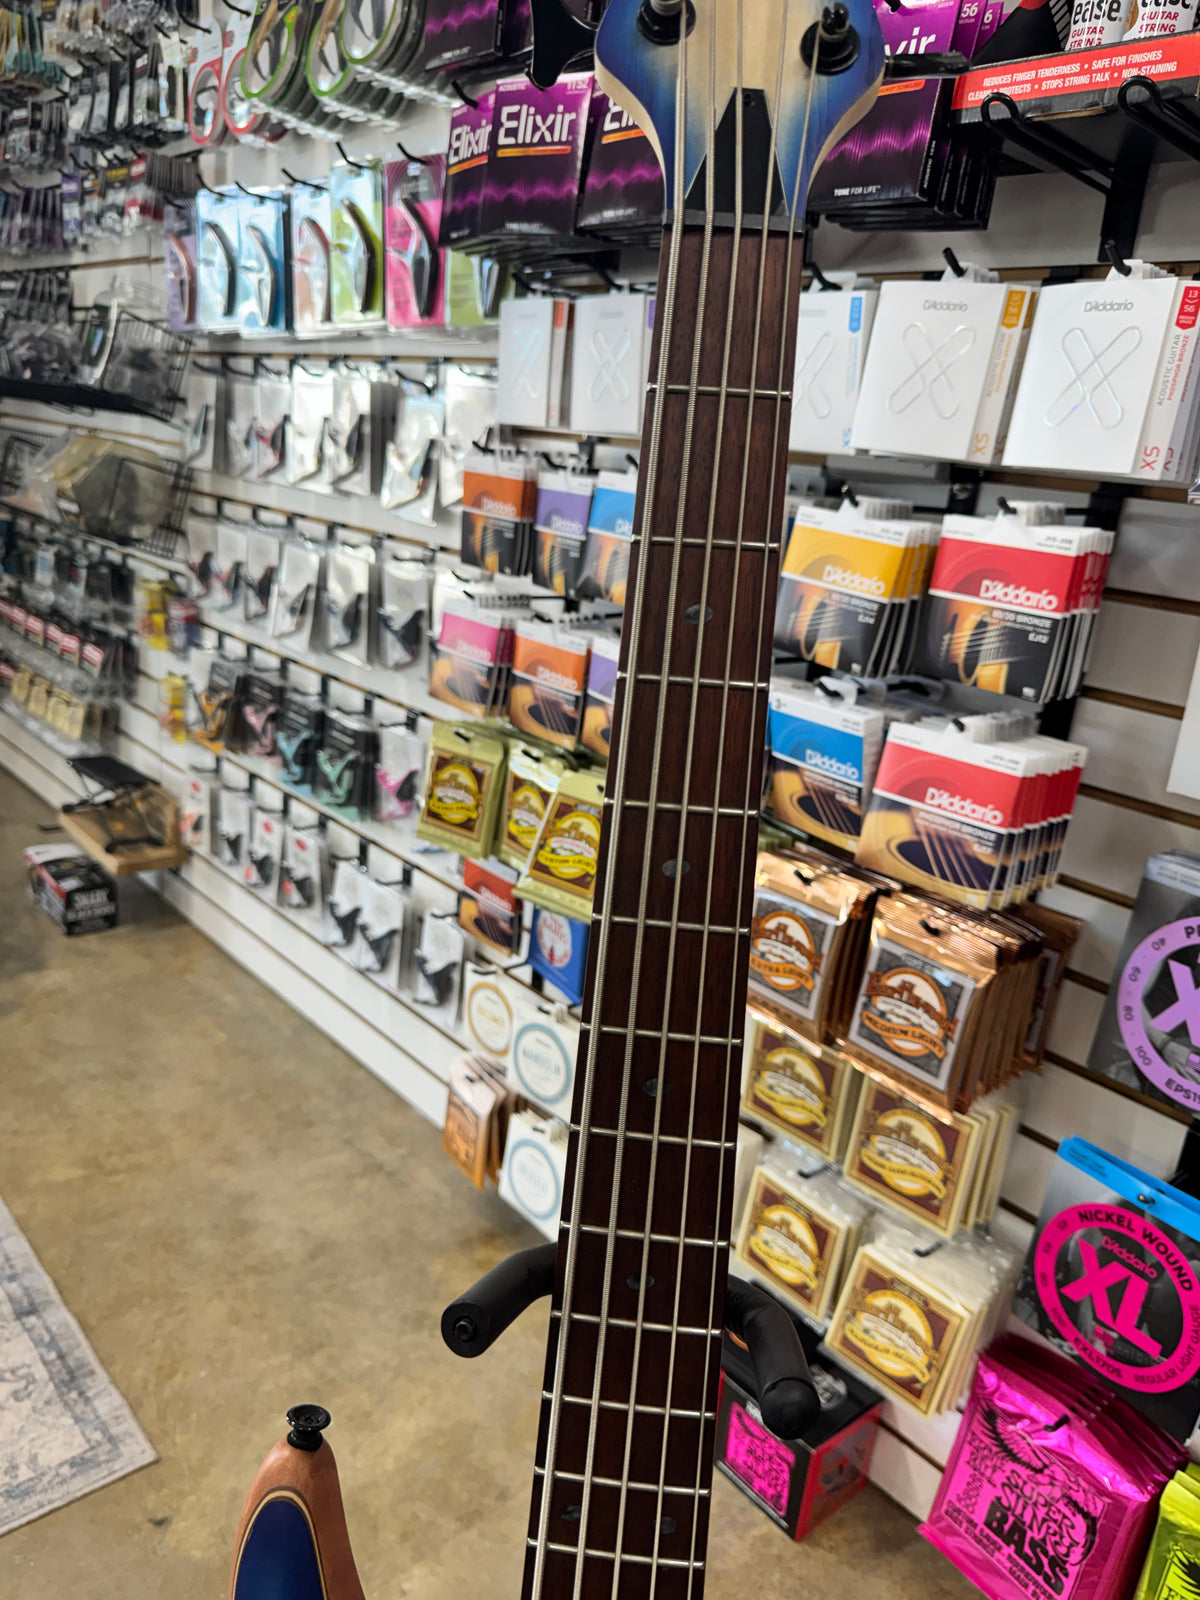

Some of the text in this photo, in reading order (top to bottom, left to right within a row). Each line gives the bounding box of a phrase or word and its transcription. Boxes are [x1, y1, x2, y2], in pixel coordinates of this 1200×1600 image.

[1072, 26, 1104, 38] GUITAR
[1138, 23, 1176, 34] STRING
[1142, 11, 1179, 21] GUITAR
[983, 50, 1162, 87] REDUCES FINGER TENDERNESS SAFE FOR FINISHES
[1041, 79, 1063, 90] STOPS
[1064, 75, 1090, 87] STRING
[1091, 72, 1110, 83] TALK
[1121, 61, 1177, 78] NON-STAINING
[449, 119, 493, 165] Elixir
[497, 104, 576, 145] Elixir
[1188, 289, 1198, 298] 13
[1157, 333, 1181, 407] ACOUSTIC GUITAR
[1140, 445, 1160, 472] XS
[979, 578, 1058, 611] D'Addario
[924, 787, 1004, 825] D'Addario
[1077, 1209, 1193, 1292] NICKEL WOUND
[1101, 1235, 1157, 1279] D'Addario
[1059, 1236, 1163, 1360] XL
[1175, 1345, 1196, 1373] LIGHT
[984, 1495, 1070, 1596] BASS
